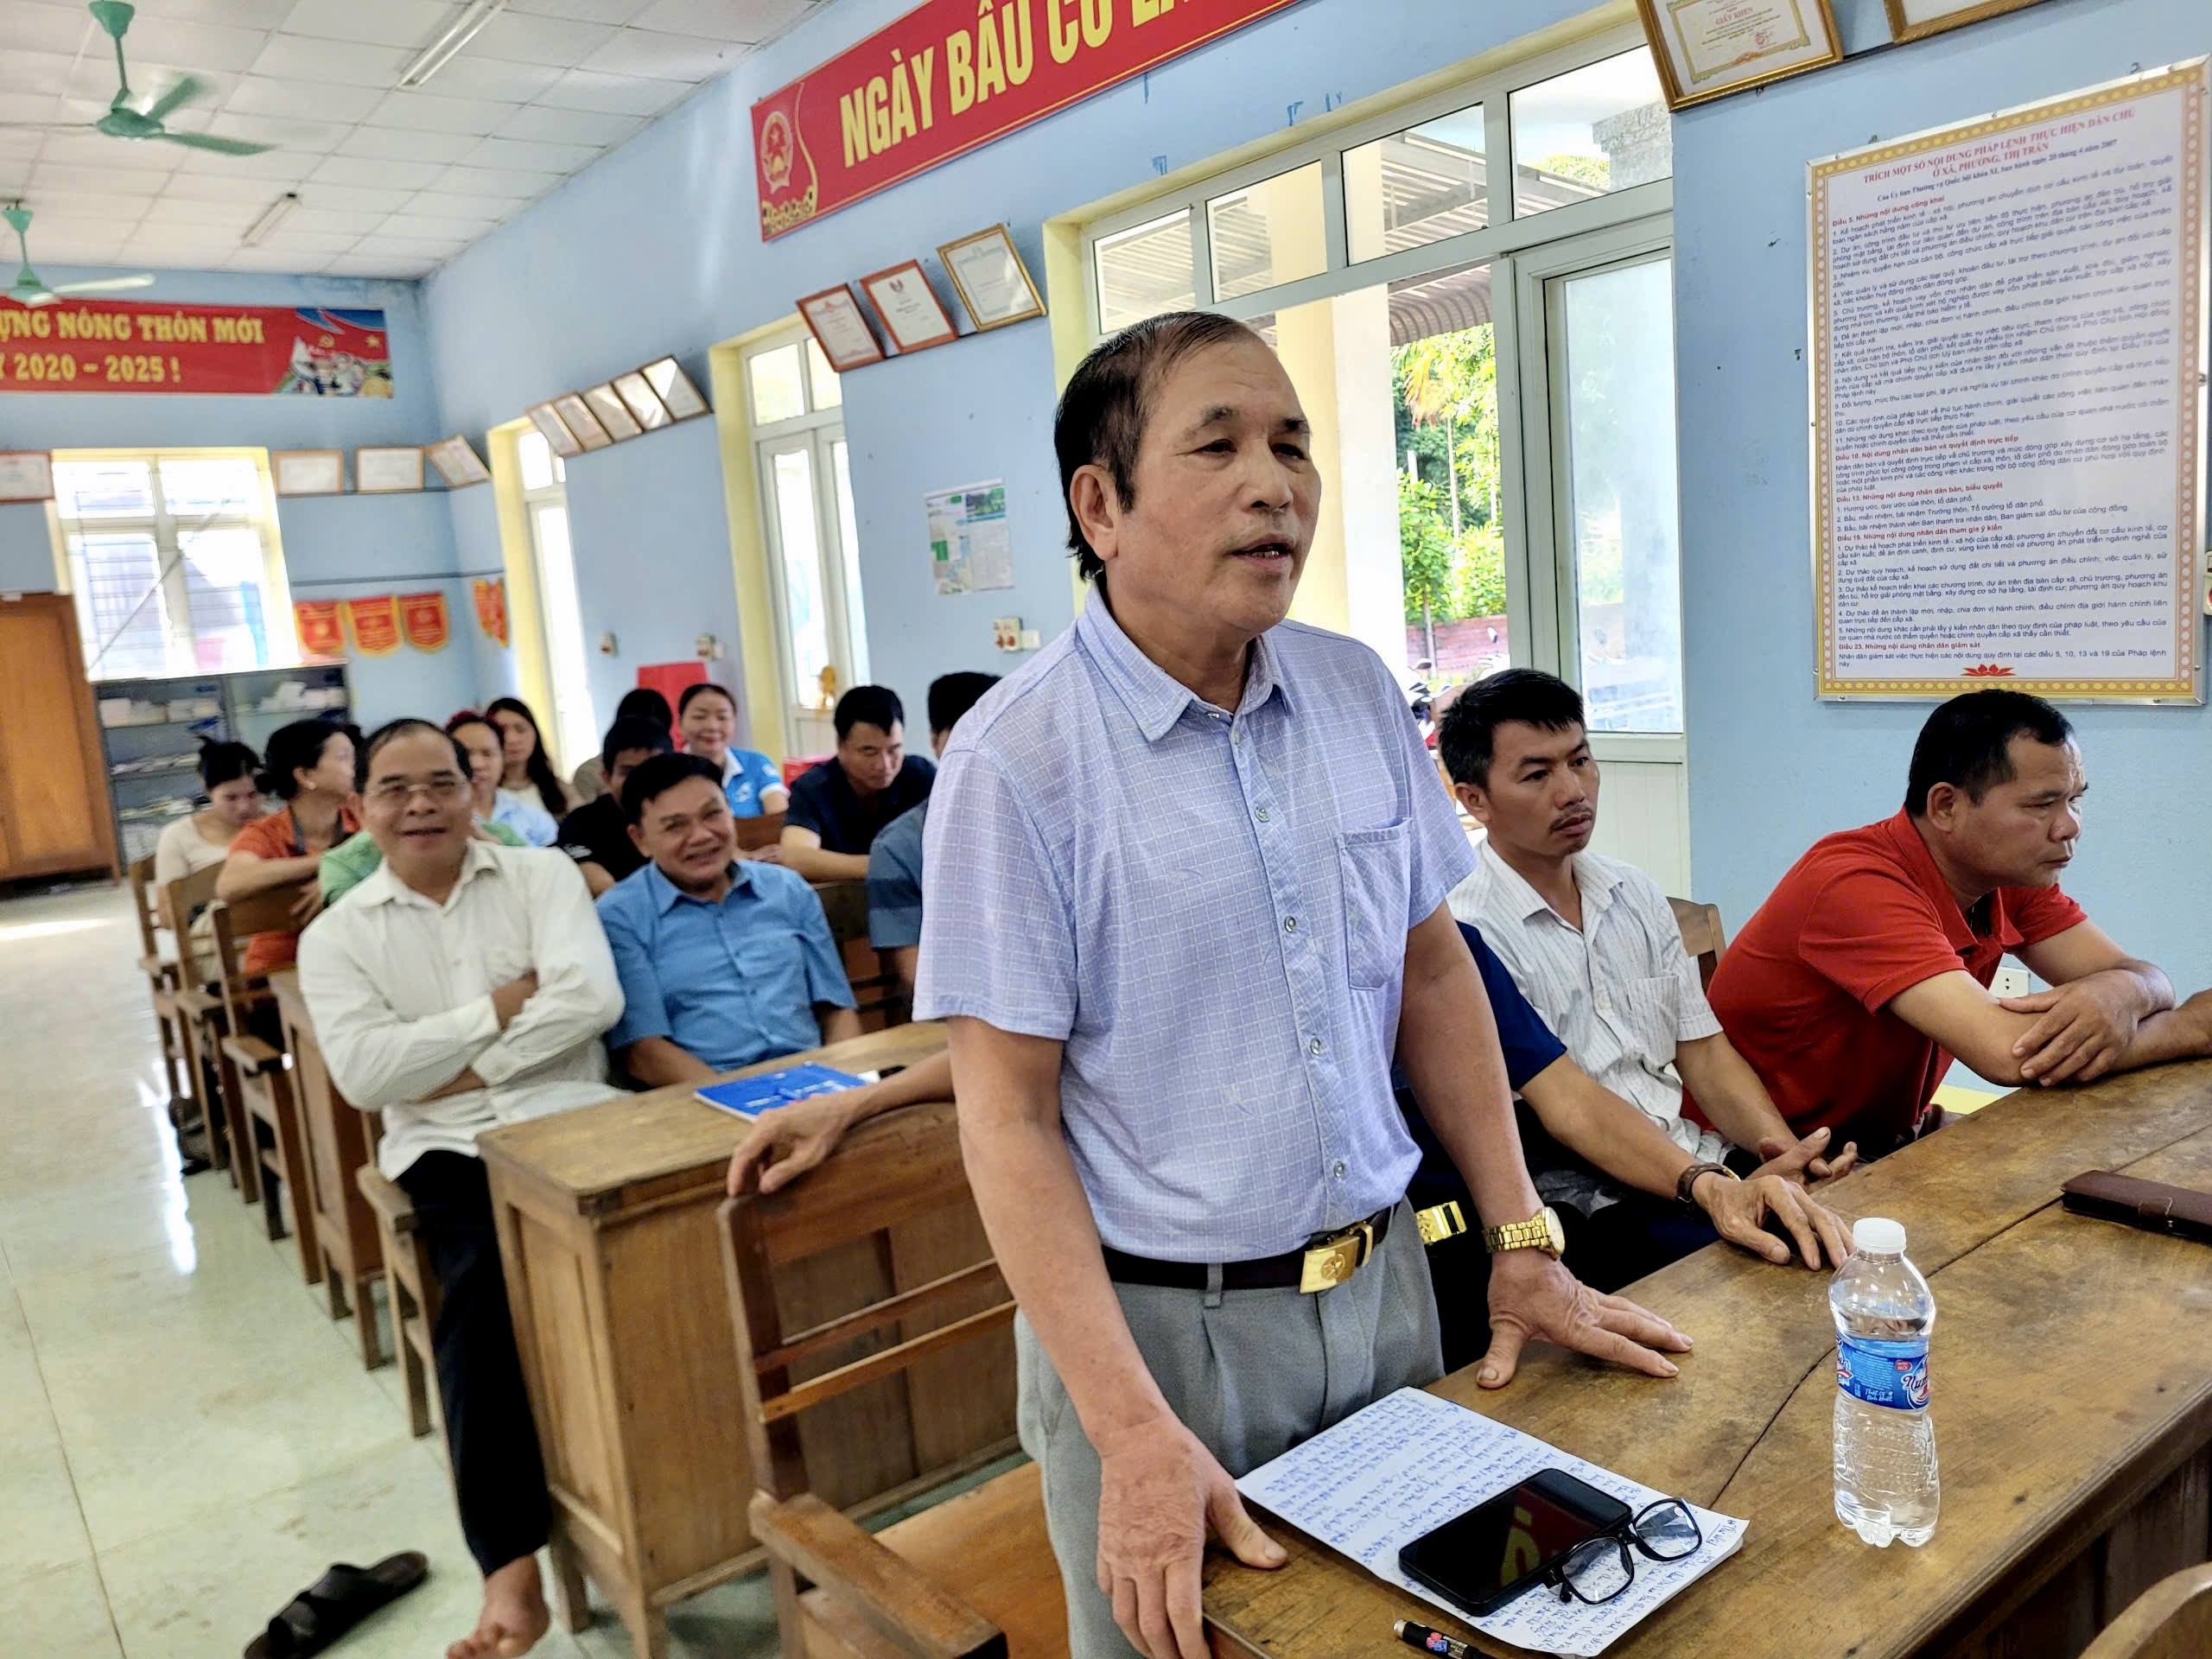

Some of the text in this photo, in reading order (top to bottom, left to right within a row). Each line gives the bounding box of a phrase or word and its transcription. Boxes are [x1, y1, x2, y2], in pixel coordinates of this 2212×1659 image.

[840, 46, 934, 168] NGÀY
[56, 306, 131, 340] NÔNG
[137, 310, 207, 342] THÔN
[212, 312, 264, 344] MỚI
[14, 353, 76, 381] 2020
[105, 354, 166, 383] 2025
